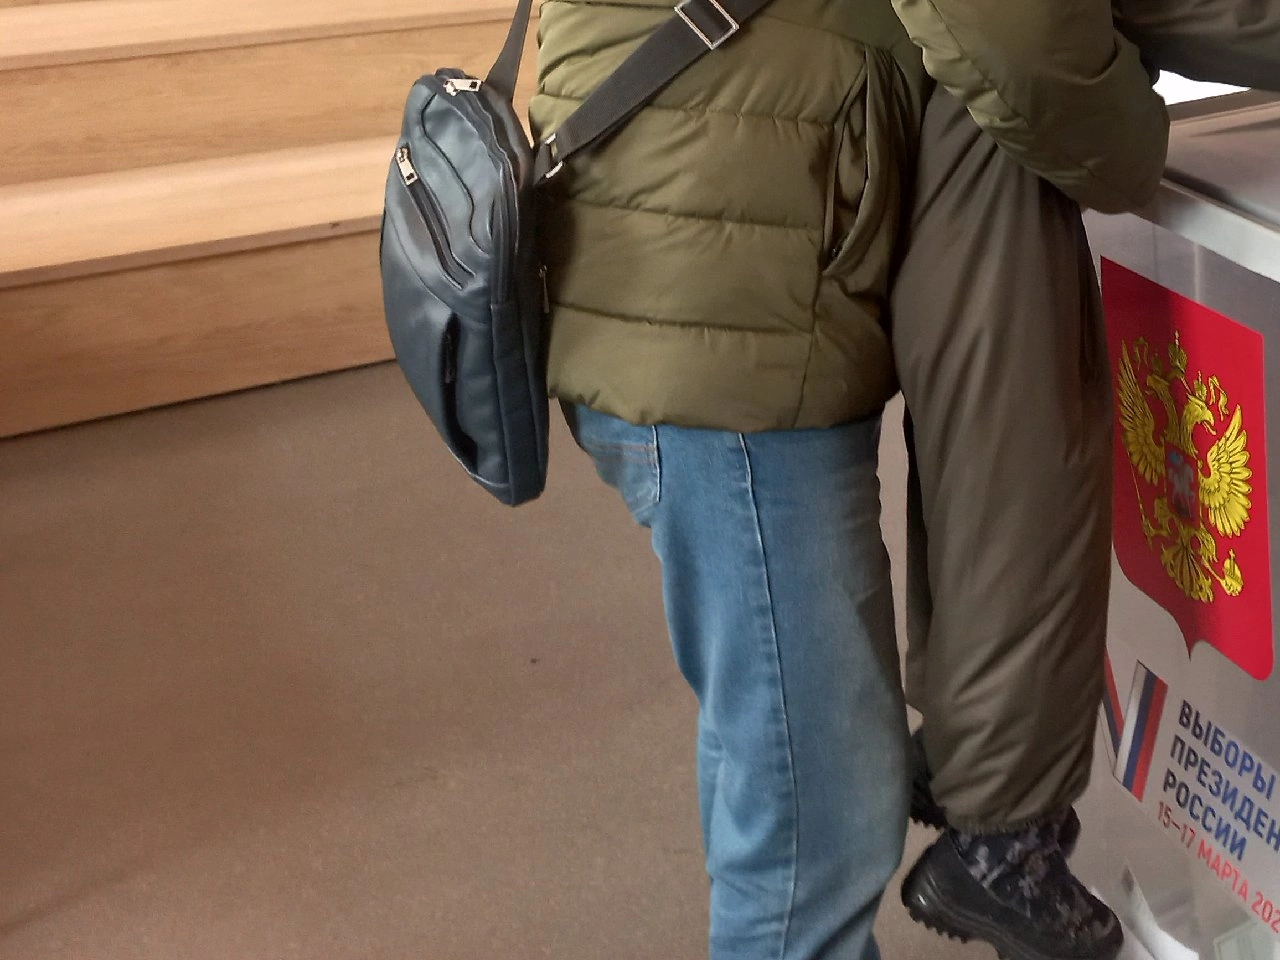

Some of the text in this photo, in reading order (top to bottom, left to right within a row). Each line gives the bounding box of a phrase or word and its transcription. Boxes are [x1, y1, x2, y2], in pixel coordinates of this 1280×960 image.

[1178, 699, 1277, 801] ВЫБОРЫ
[1163, 768, 1248, 862] РОССИИ
[1196, 837, 1249, 903] МАРТА
